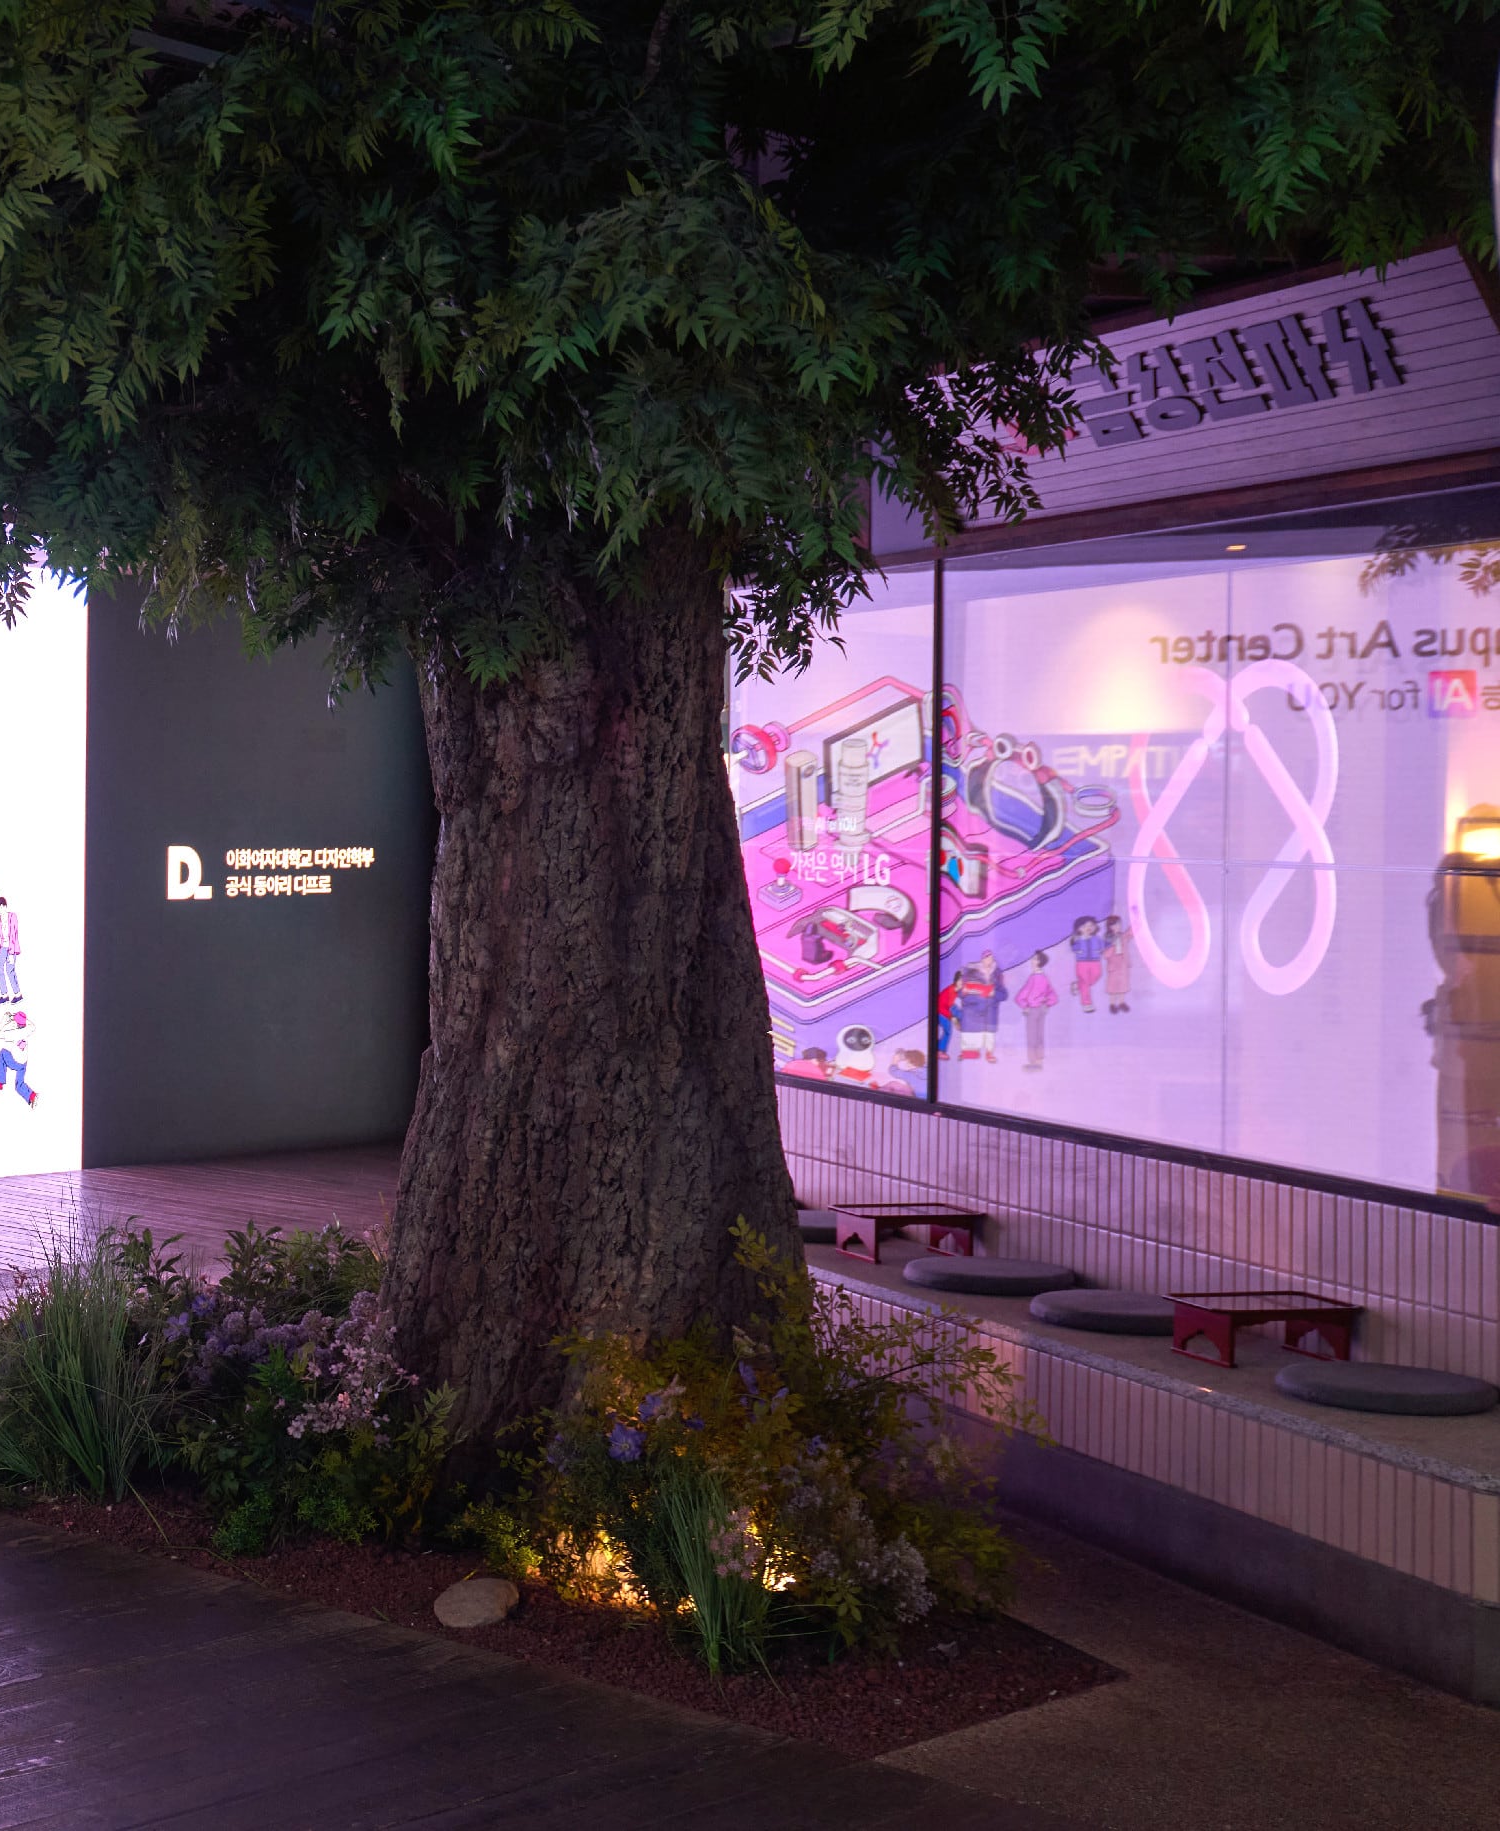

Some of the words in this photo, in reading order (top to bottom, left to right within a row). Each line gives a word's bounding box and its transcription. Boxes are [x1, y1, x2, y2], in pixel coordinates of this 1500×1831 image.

[1069, 299, 1405, 448] 금성전파사
[225, 848, 314, 870] 이화여자대학교
[314, 847, 375, 870] 디자인학부
[863, 852, 892, 886] LG
[225, 875, 251, 897] 공식
[253, 875, 291, 897] 동아리
